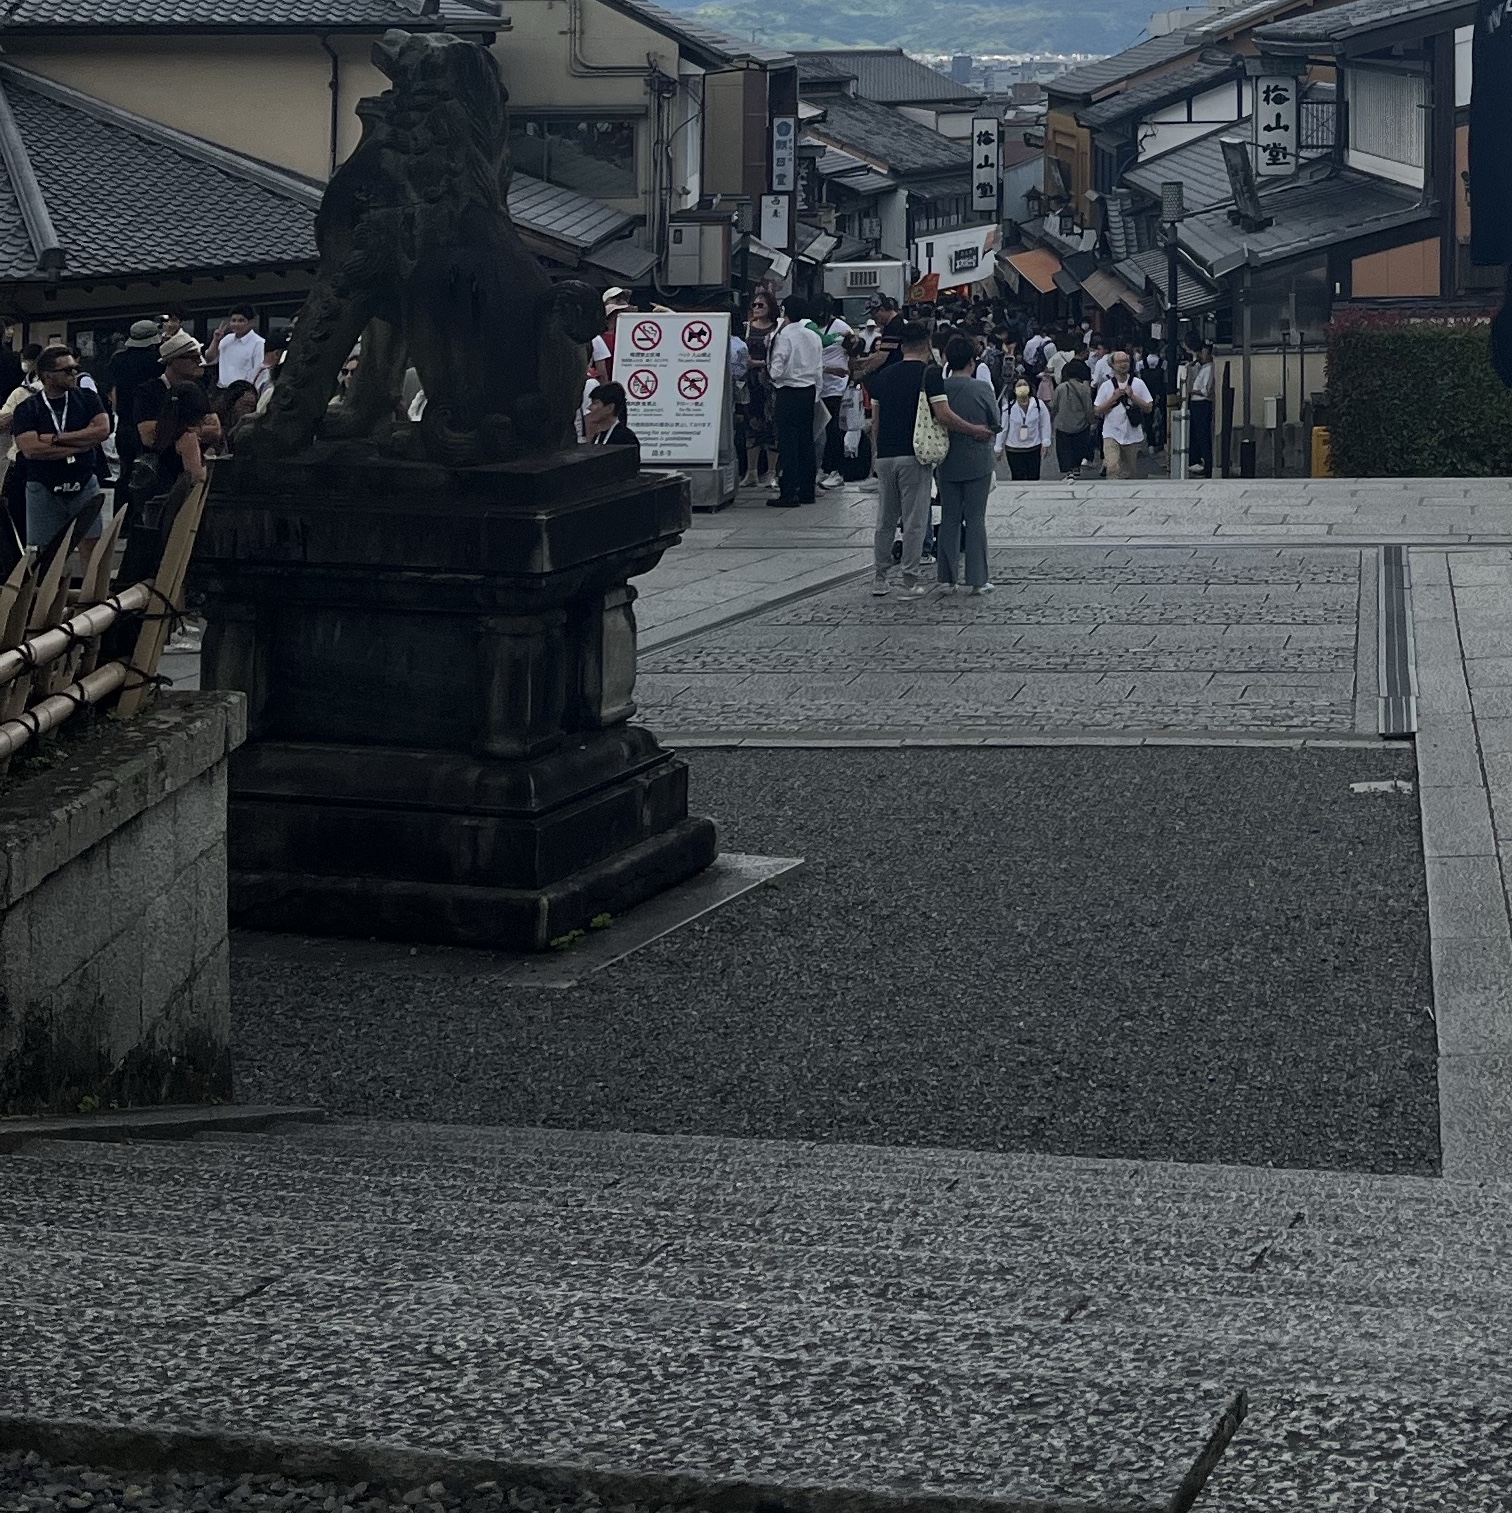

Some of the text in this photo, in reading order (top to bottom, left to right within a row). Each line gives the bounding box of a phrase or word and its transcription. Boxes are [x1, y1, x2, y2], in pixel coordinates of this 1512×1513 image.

[1262, 84, 1292, 167] 梅山堂
[975, 129, 996, 199] 梅山堂
